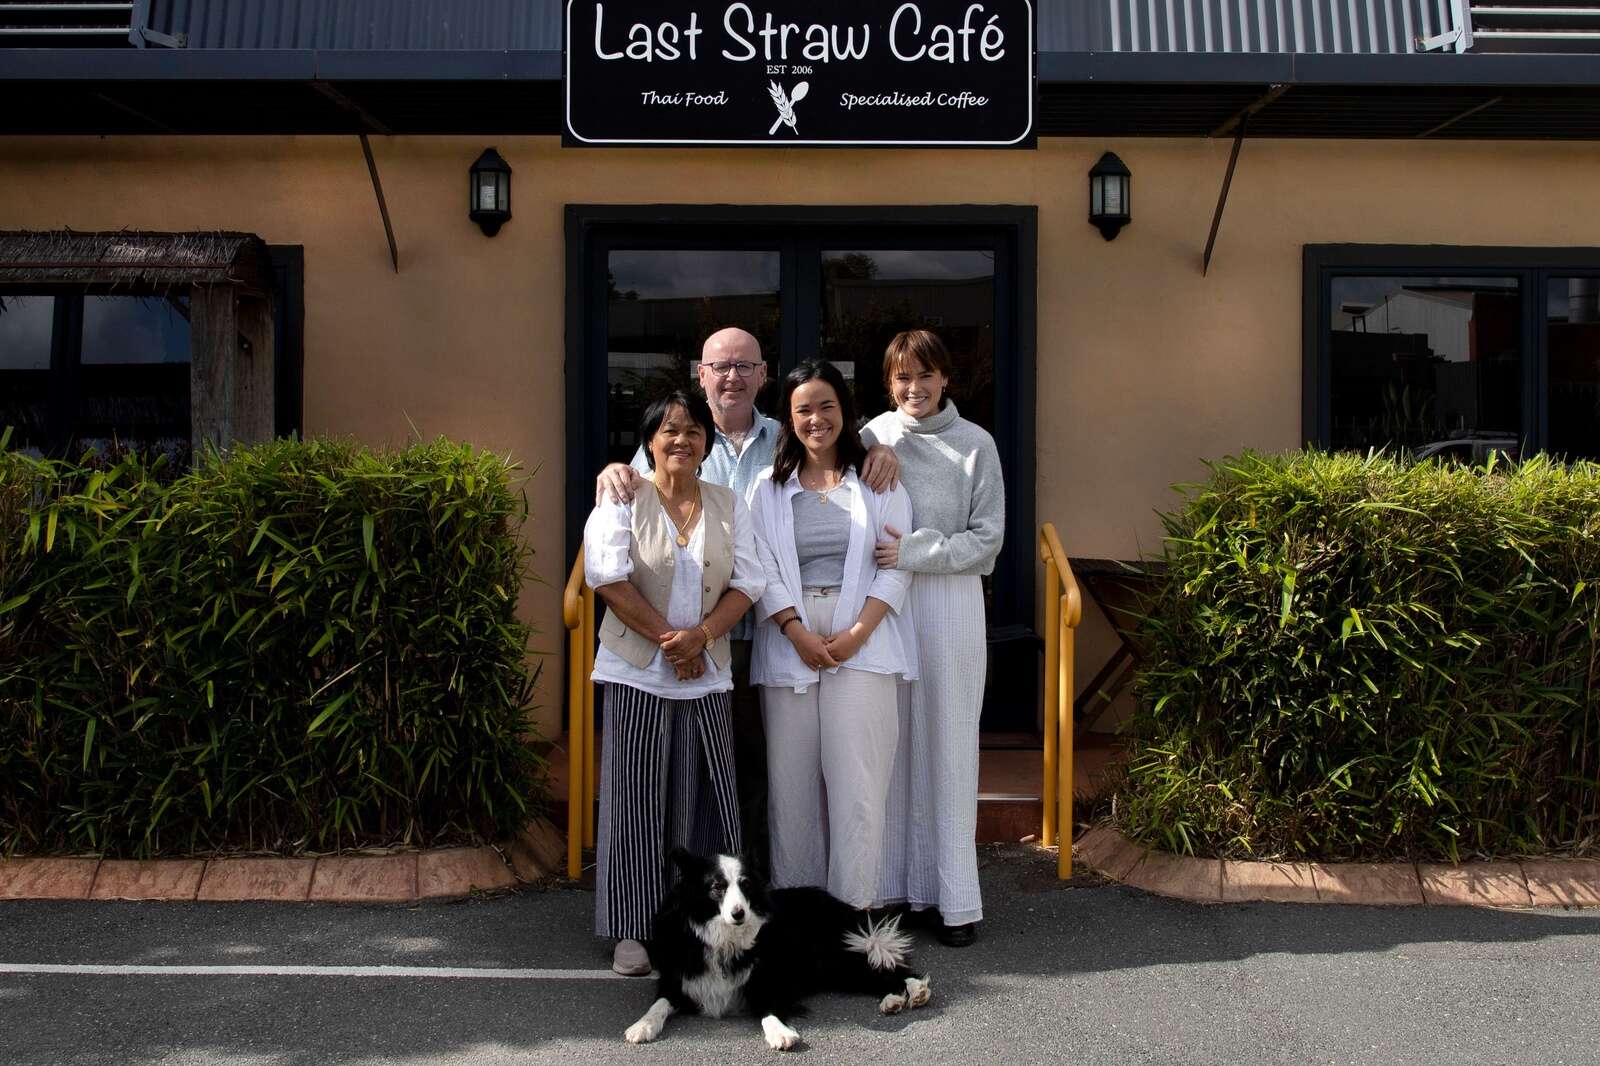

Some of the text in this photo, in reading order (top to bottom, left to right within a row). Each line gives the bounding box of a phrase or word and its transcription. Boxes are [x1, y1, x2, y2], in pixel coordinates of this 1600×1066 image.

[594, 2, 1006, 64] Last Straw Café
[766, 65, 813, 75] EST 2006
[641, 90, 729, 106] Thai Food
[839, 91, 990, 110] Specialised Coffee
